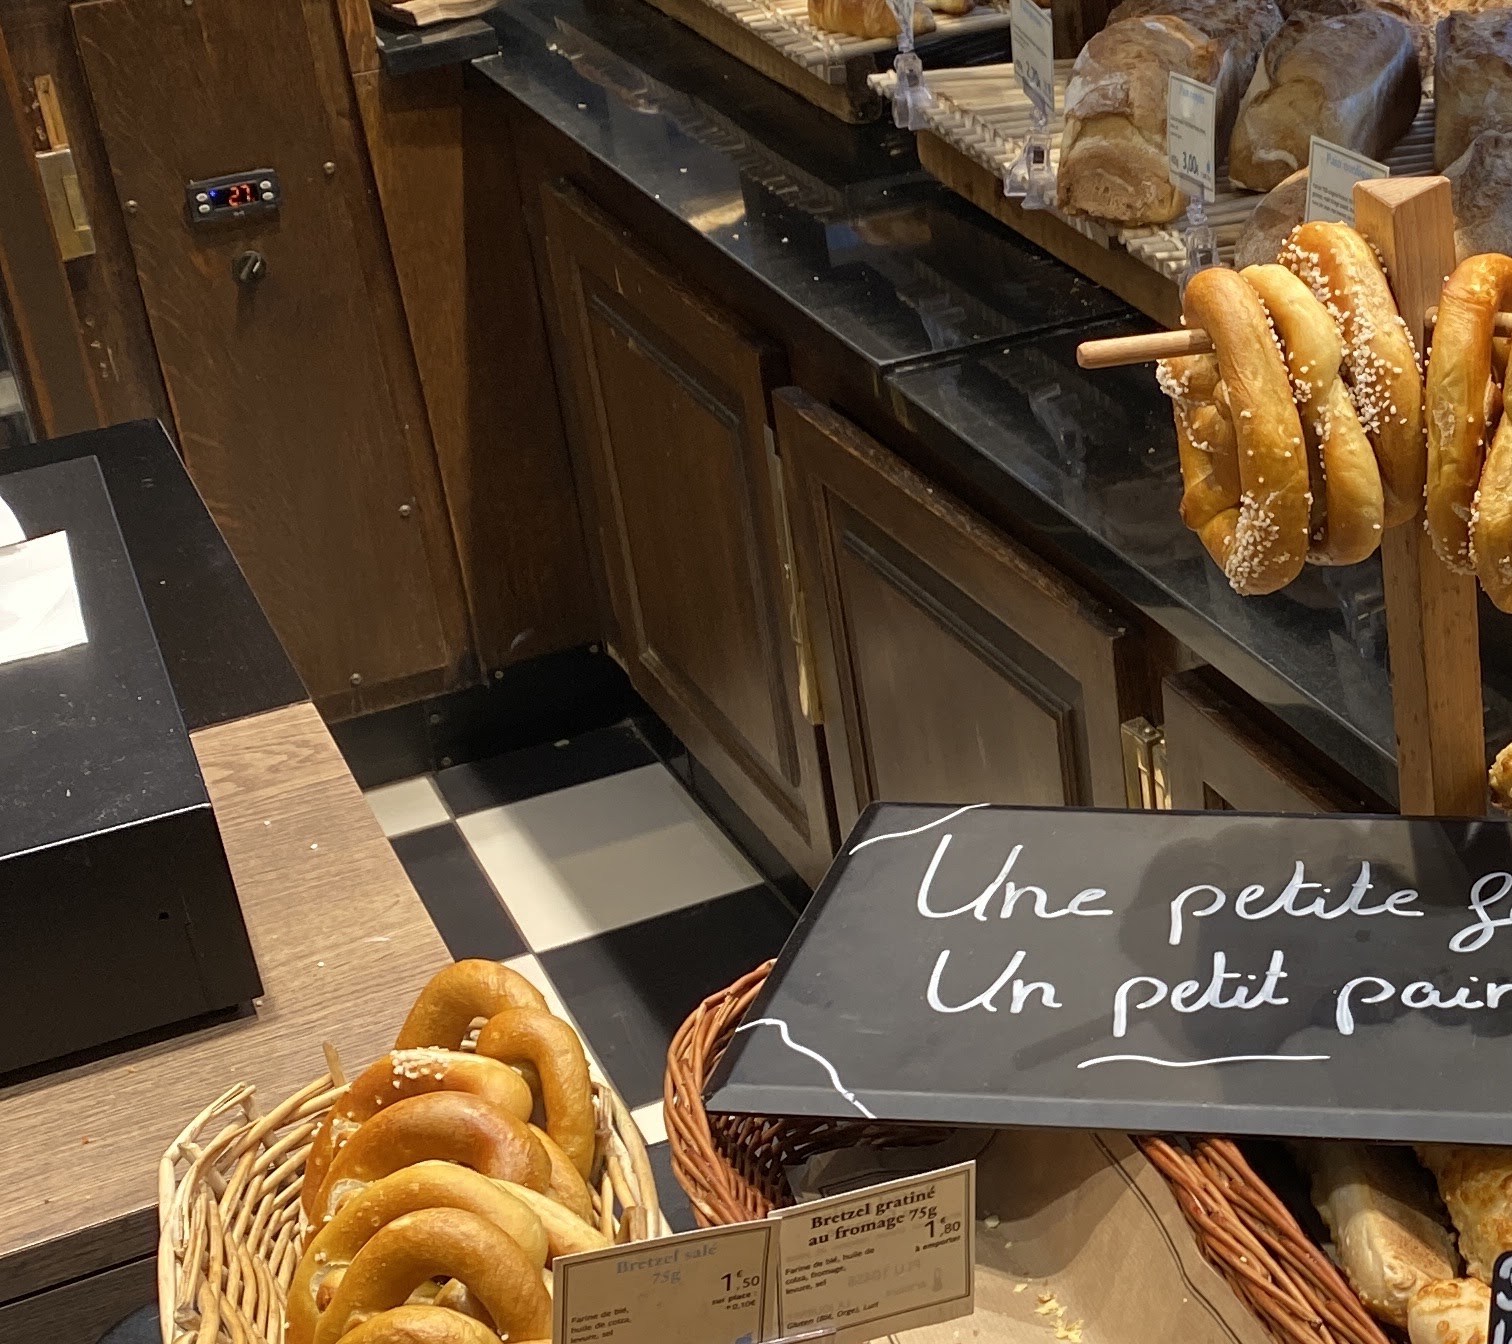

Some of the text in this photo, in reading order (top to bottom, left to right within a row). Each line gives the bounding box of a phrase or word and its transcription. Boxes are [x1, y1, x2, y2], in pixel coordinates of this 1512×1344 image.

[228, 184, 251, 208] 27
[917, 833, 1114, 922] Une
[1169, 860, 1425, 946] petite
[926, 949, 1063, 1014] Un
[1112, 949, 1290, 1038] petit
[811, 1185, 936, 1230] Bretzel gratiné
[808, 1206, 938, 1247] au fromage 75g
[922, 1235, 961, 1250] emporter
[616, 1243, 718, 1275] Bretzel salé
[785, 1264, 811, 1276] Farine
[813, 1260, 823, 1268] de
[843, 1251, 862, 1261] huile
[864, 1247, 875, 1255] de
[652, 1270, 681, 1285] 75g
[815, 1279, 827, 1288] sel
[571, 1312, 599, 1324] Farine
[601, 1309, 612, 1319] de
[787, 1318, 814, 1330] Gluten
[570, 1323, 593, 1334] huile
[594, 1320, 606, 1329] de
[602, 1329, 614, 1338] sel
